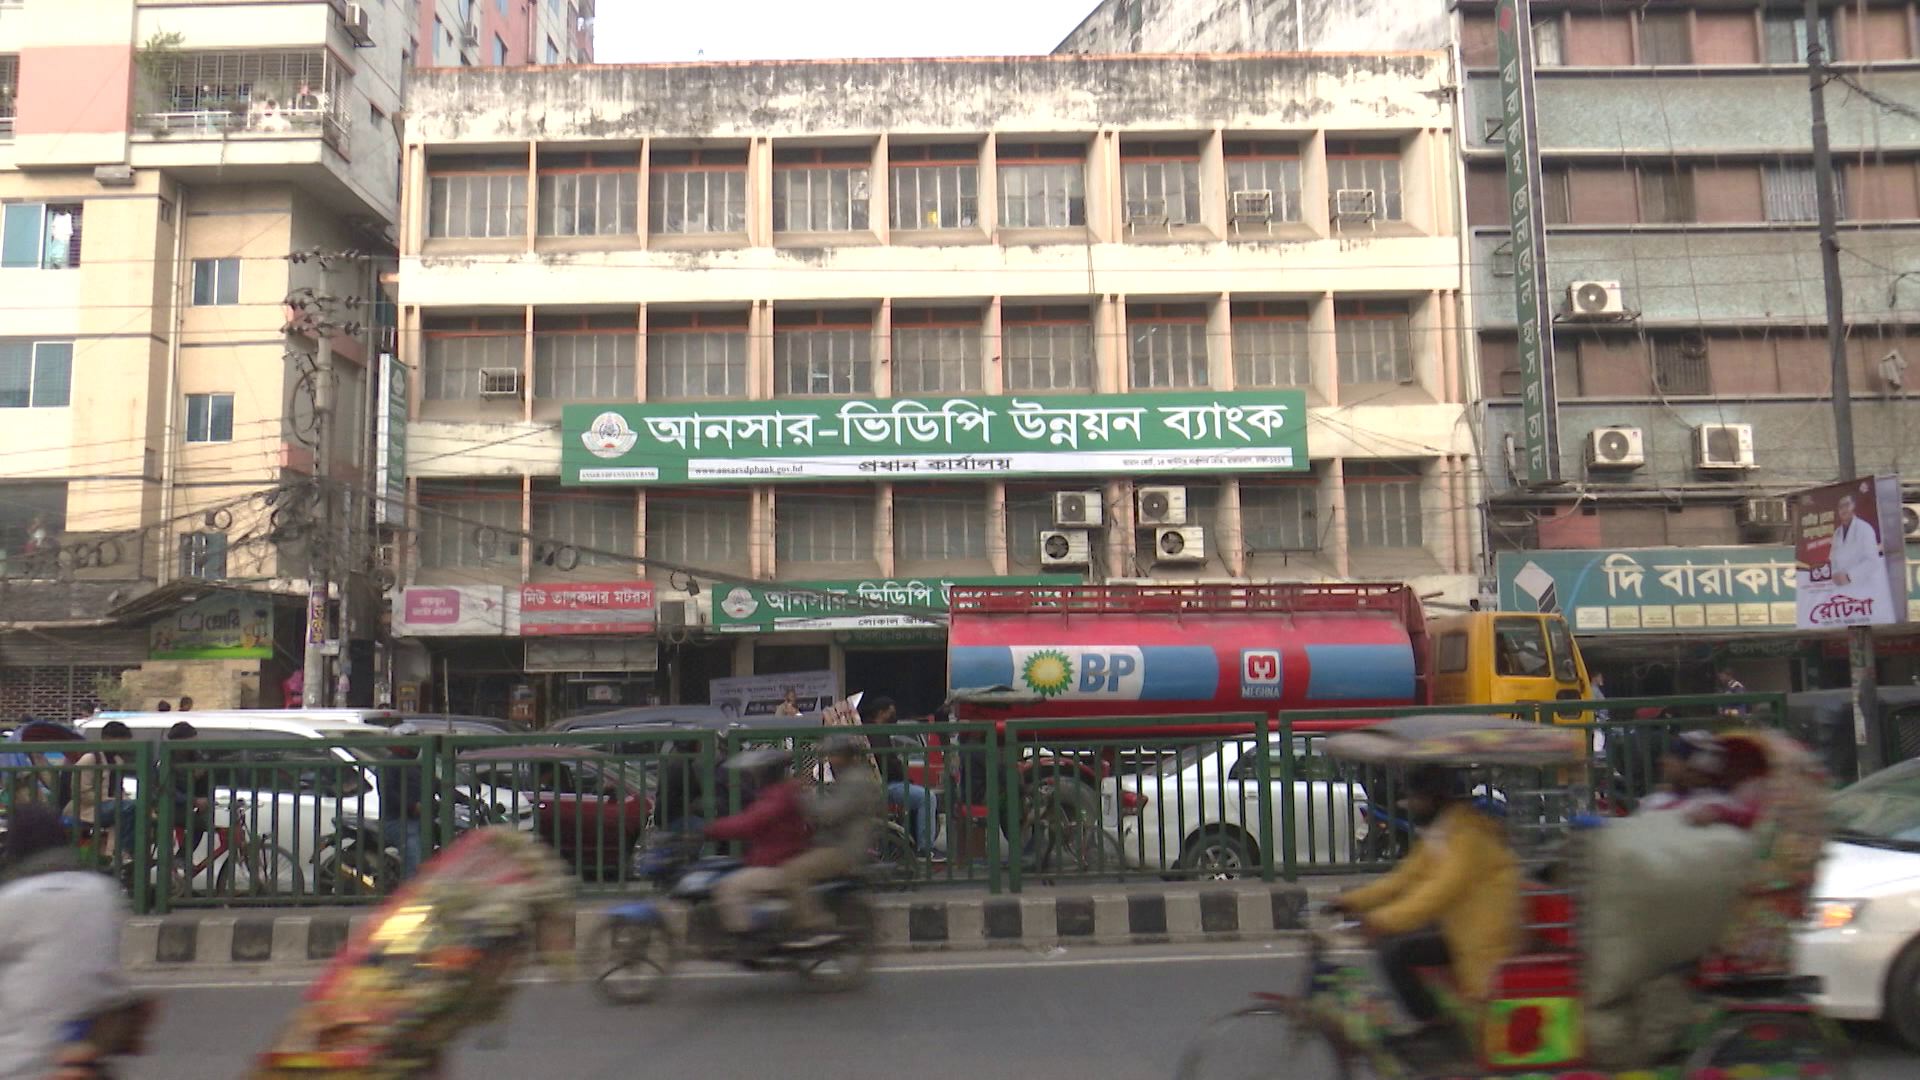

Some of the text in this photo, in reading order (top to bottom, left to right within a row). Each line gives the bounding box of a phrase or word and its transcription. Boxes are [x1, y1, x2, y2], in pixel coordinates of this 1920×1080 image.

[643, 397, 1288, 450] আনসার-ভিডিপি উন্নয়ন ব্যাংক
[858, 454, 1014, 473] প্রধান কার্যালয়
[1602, 553, 1646, 600] দি
[1809, 594, 1875, 624] রেটিনা
[1079, 652, 1136, 693] BP
[1242, 686, 1280, 698] MEGHNA
